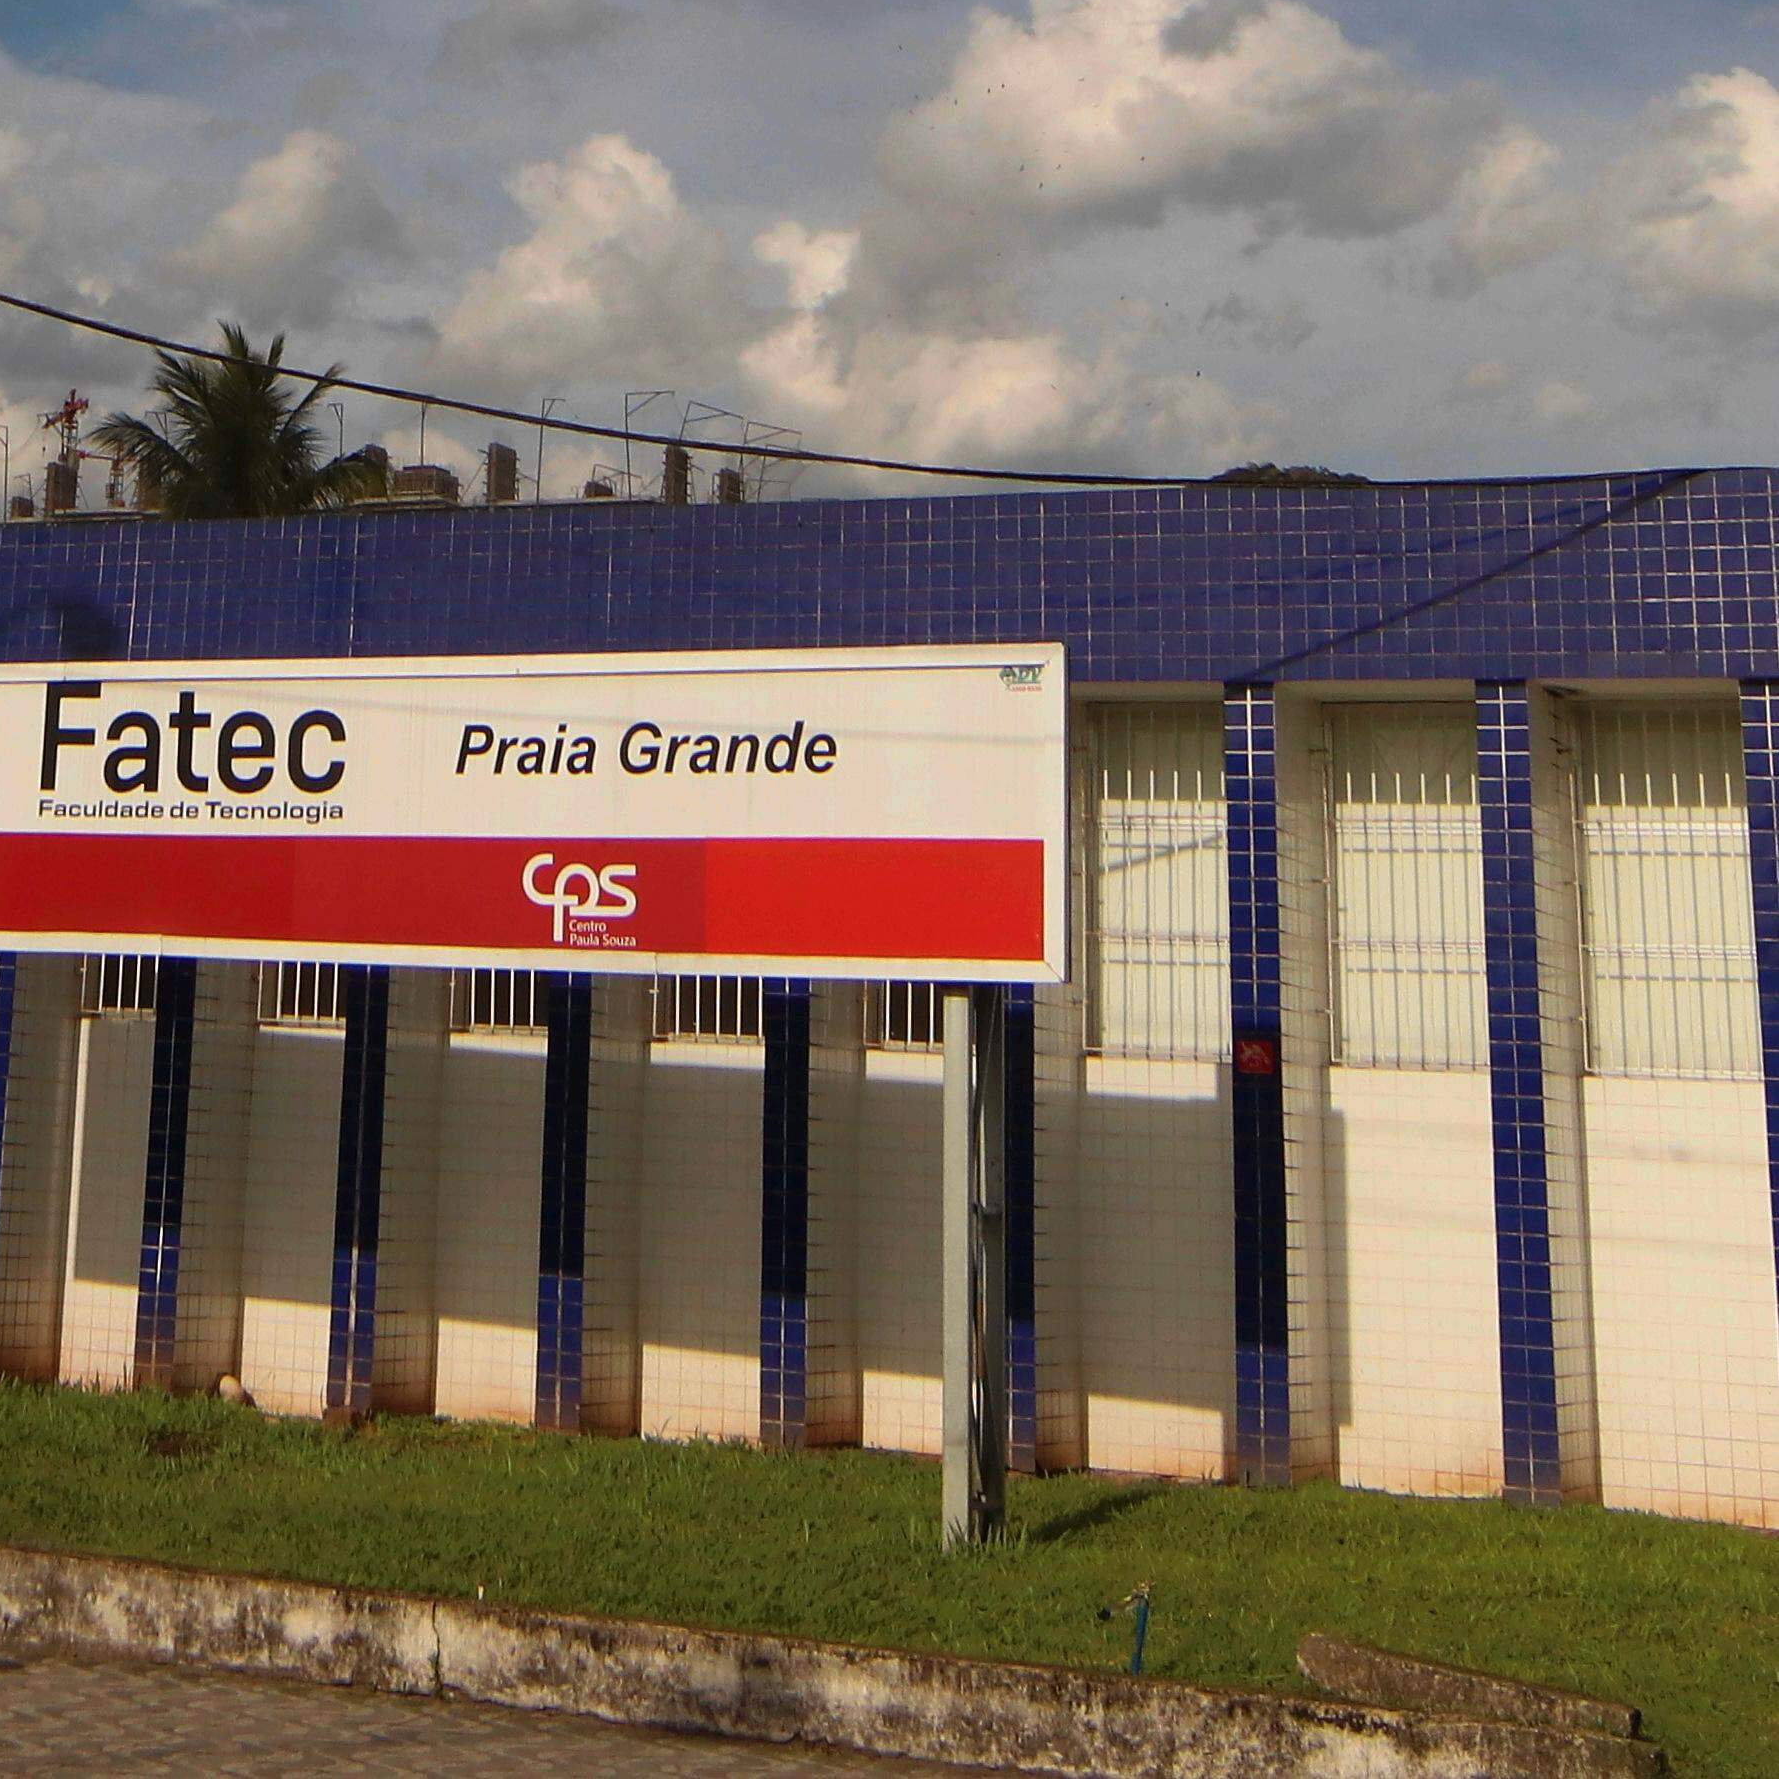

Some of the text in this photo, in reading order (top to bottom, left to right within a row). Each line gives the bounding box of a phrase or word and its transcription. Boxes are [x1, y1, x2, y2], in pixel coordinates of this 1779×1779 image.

[39, 681, 346, 794] Fatec
[455, 720, 838, 775] Praia Grande
[38, 799, 344, 825] Faculdade de Tecnologia
[569, 919, 607, 933] Centro
[569, 933, 637, 947] Paula Souza
